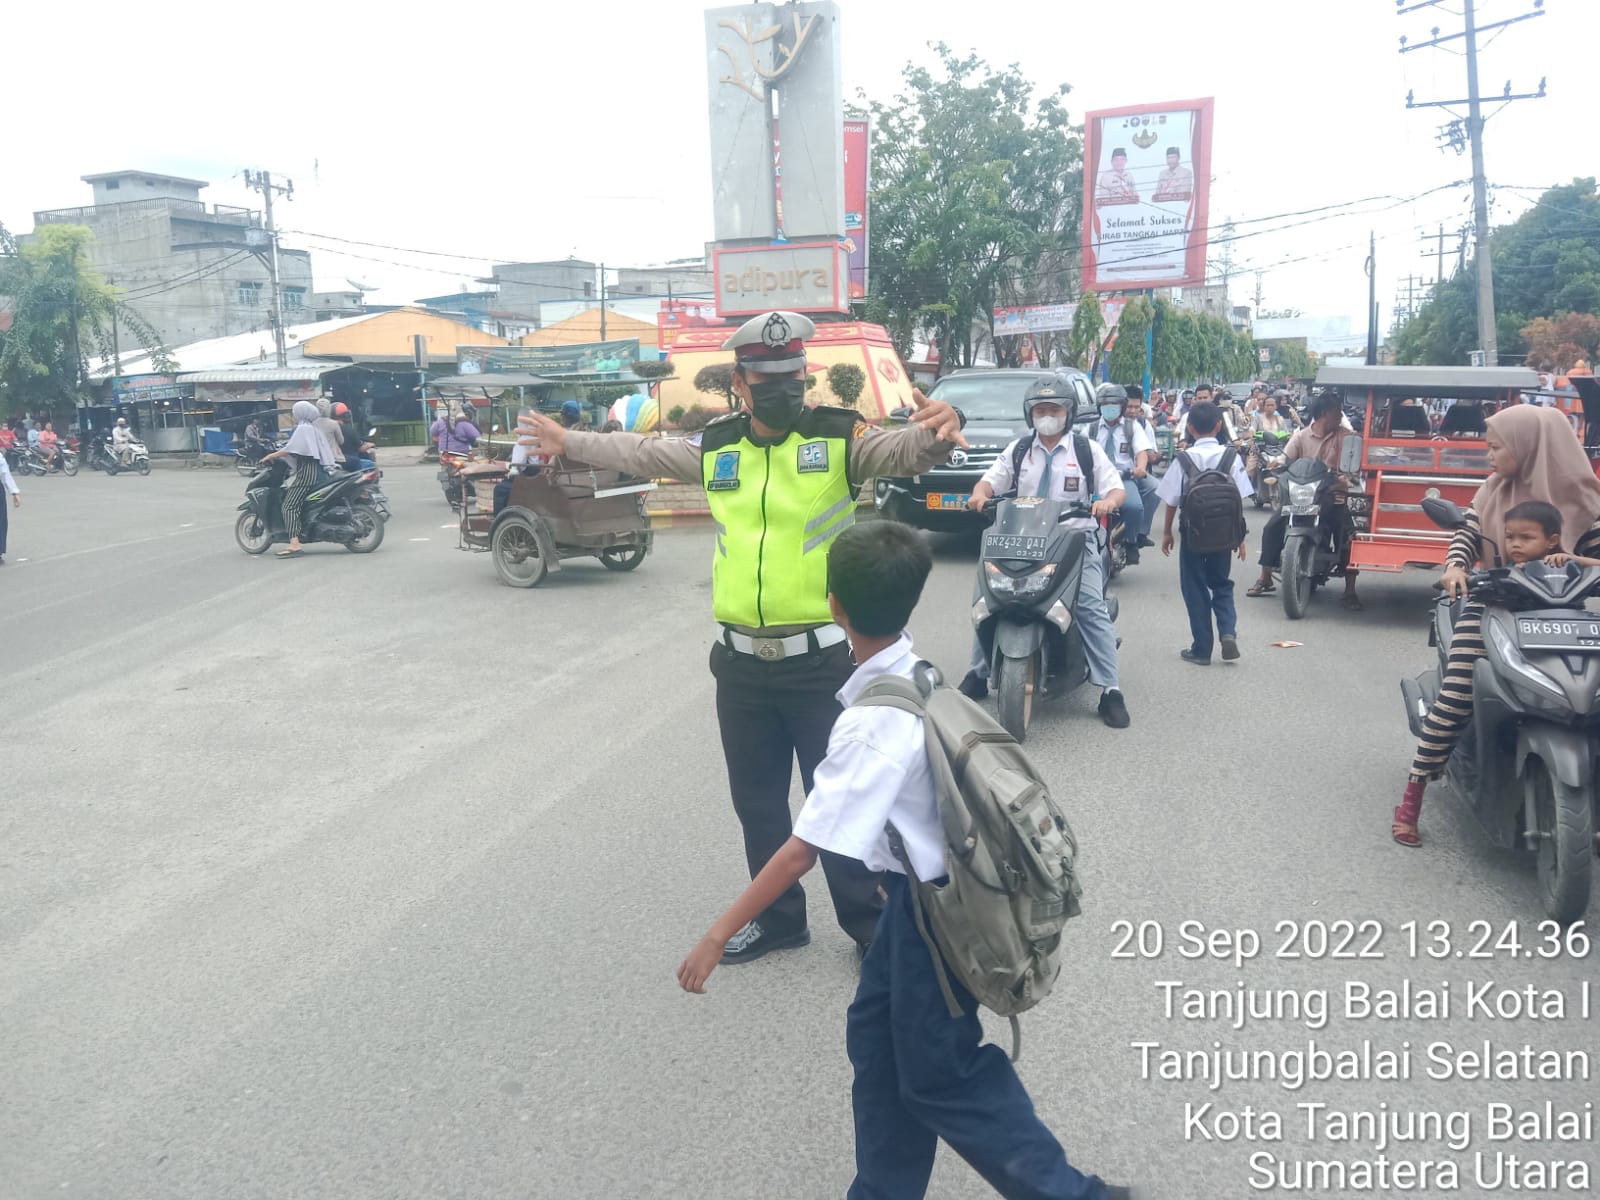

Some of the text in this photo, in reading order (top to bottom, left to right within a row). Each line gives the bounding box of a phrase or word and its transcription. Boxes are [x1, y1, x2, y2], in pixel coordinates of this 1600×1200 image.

[1106, 214, 1182, 229] Selamat Sukses
[723, 265, 828, 296] adipura
